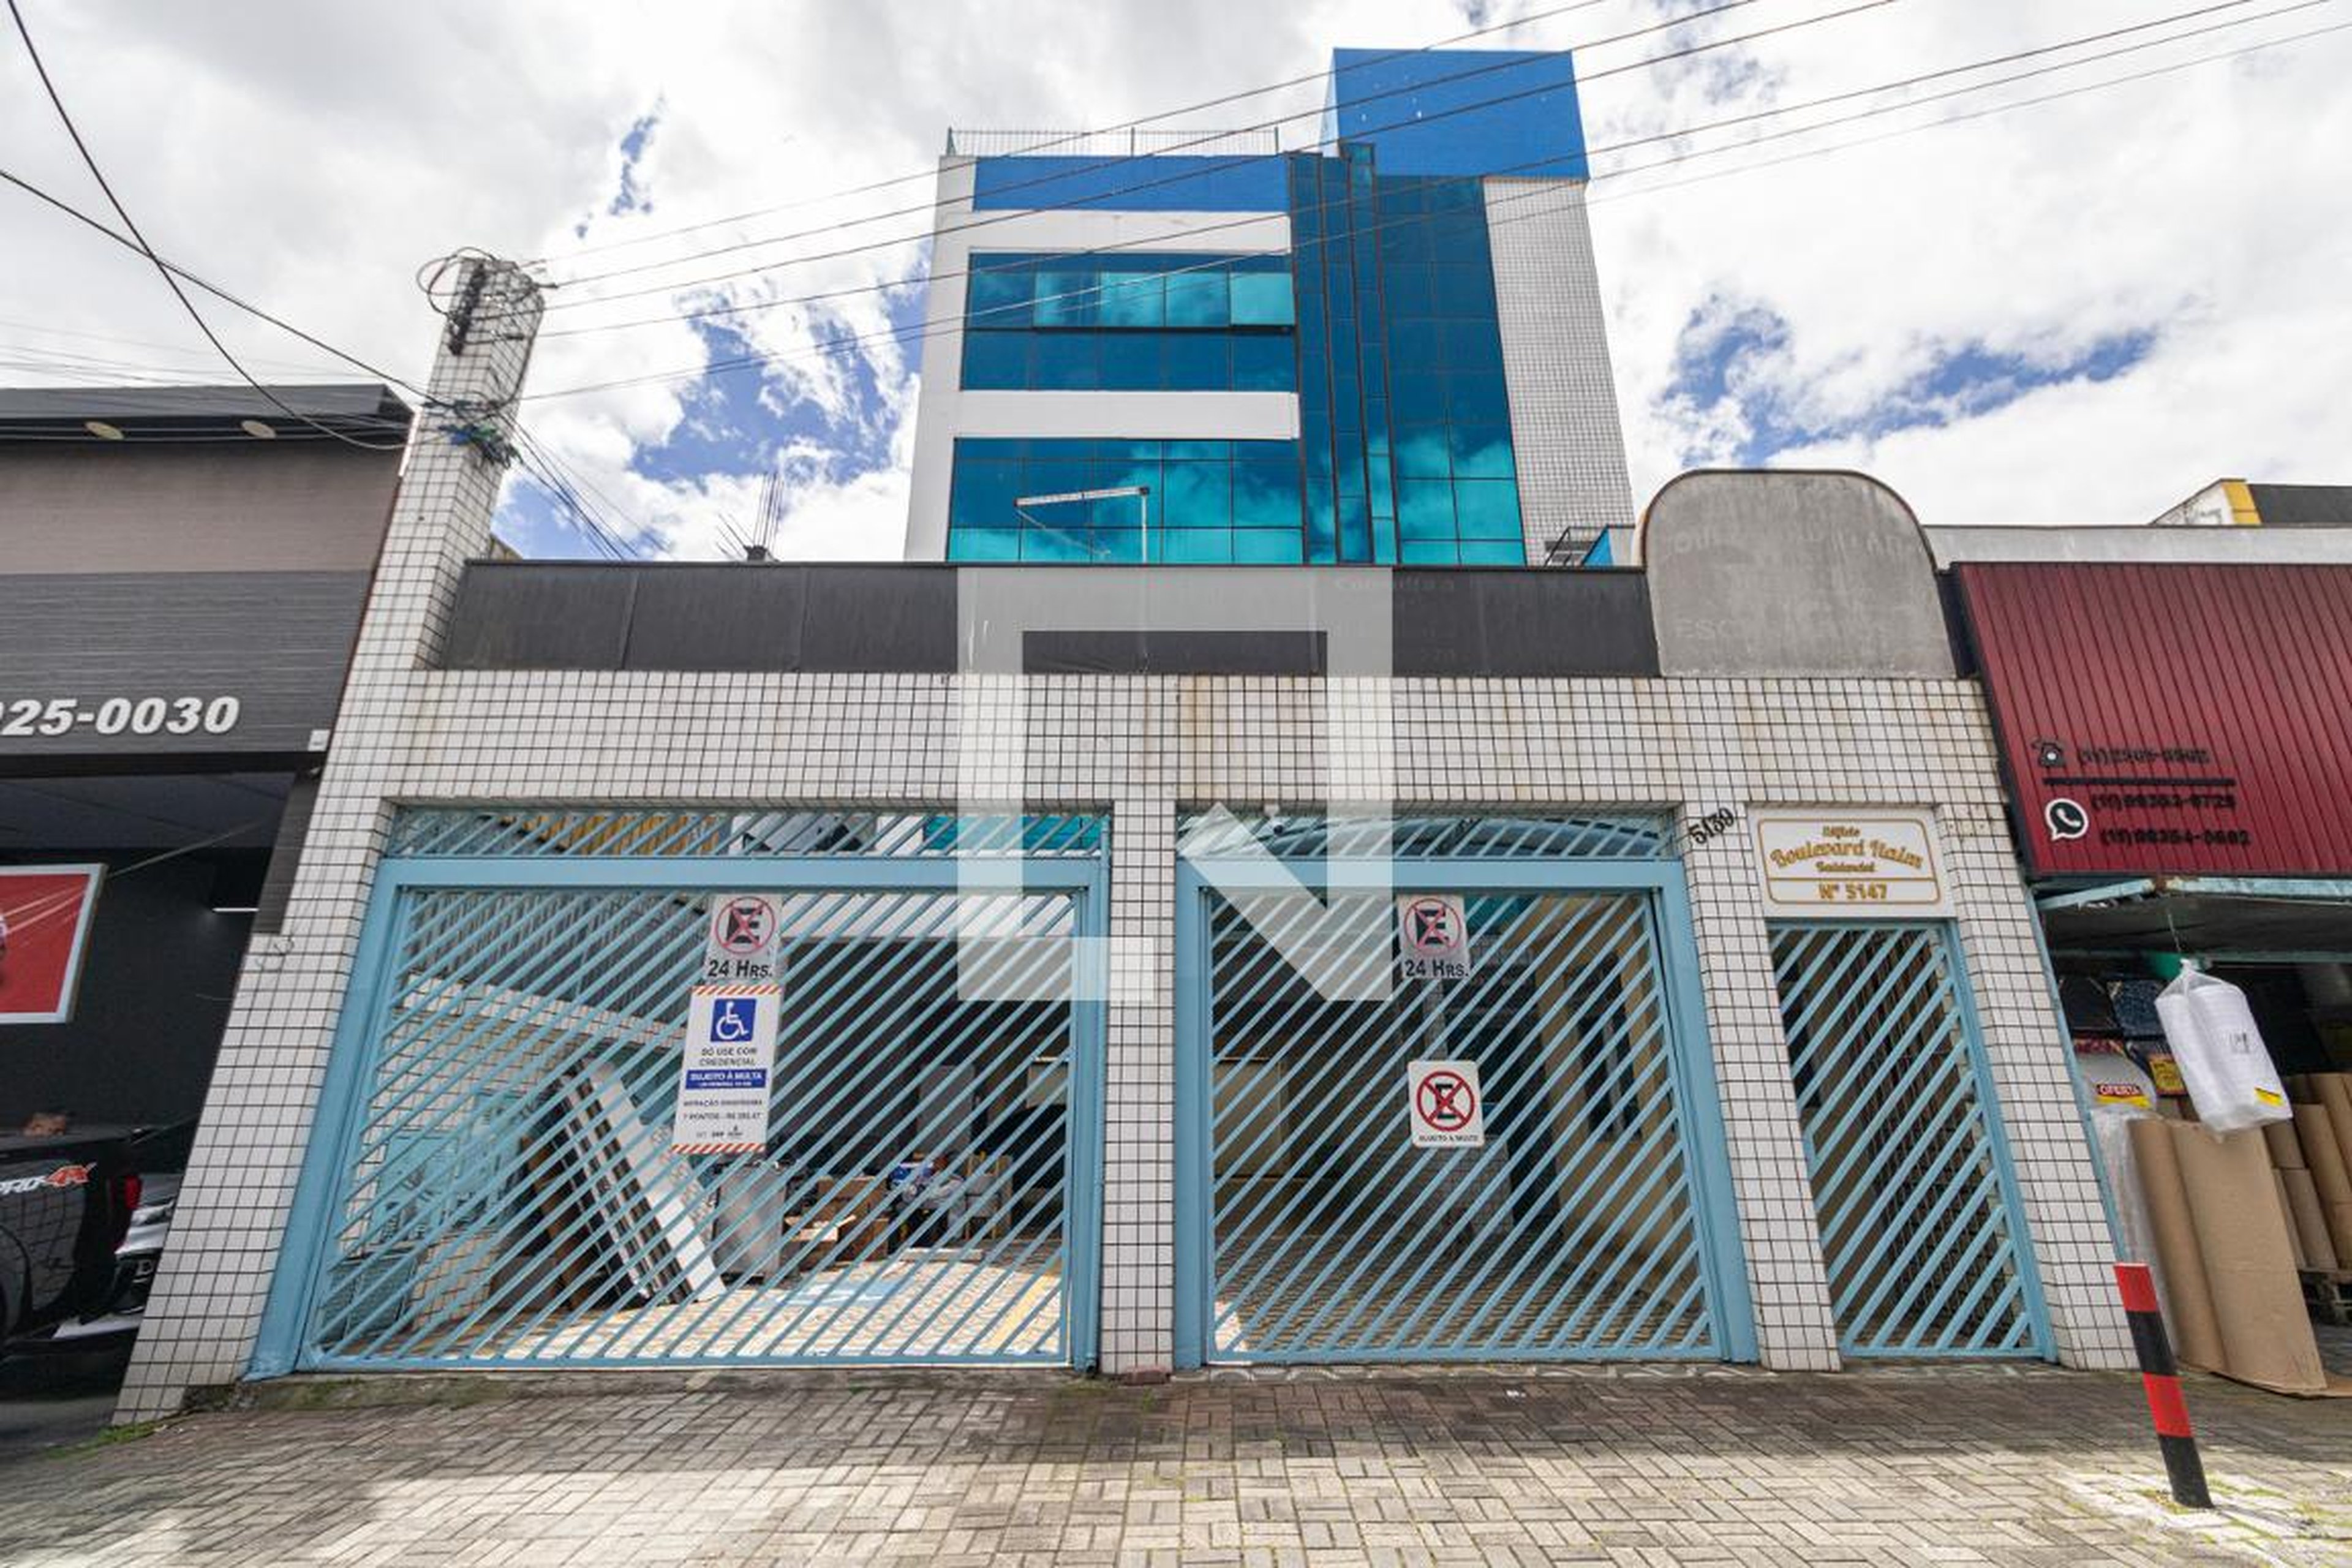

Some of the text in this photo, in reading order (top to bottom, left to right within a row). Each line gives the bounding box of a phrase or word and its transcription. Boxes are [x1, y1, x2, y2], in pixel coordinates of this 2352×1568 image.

[0, 696, 240, 736] 25-0030
[1687, 807, 1734, 845] 5139
[708, 959, 729, 977] 24
[1404, 959, 1427, 977] 24
[717, 1047, 734, 1056] USE
[699, 1058, 756, 1066] CREDENCIAL
[734, 1071, 763, 1080] MULTA
